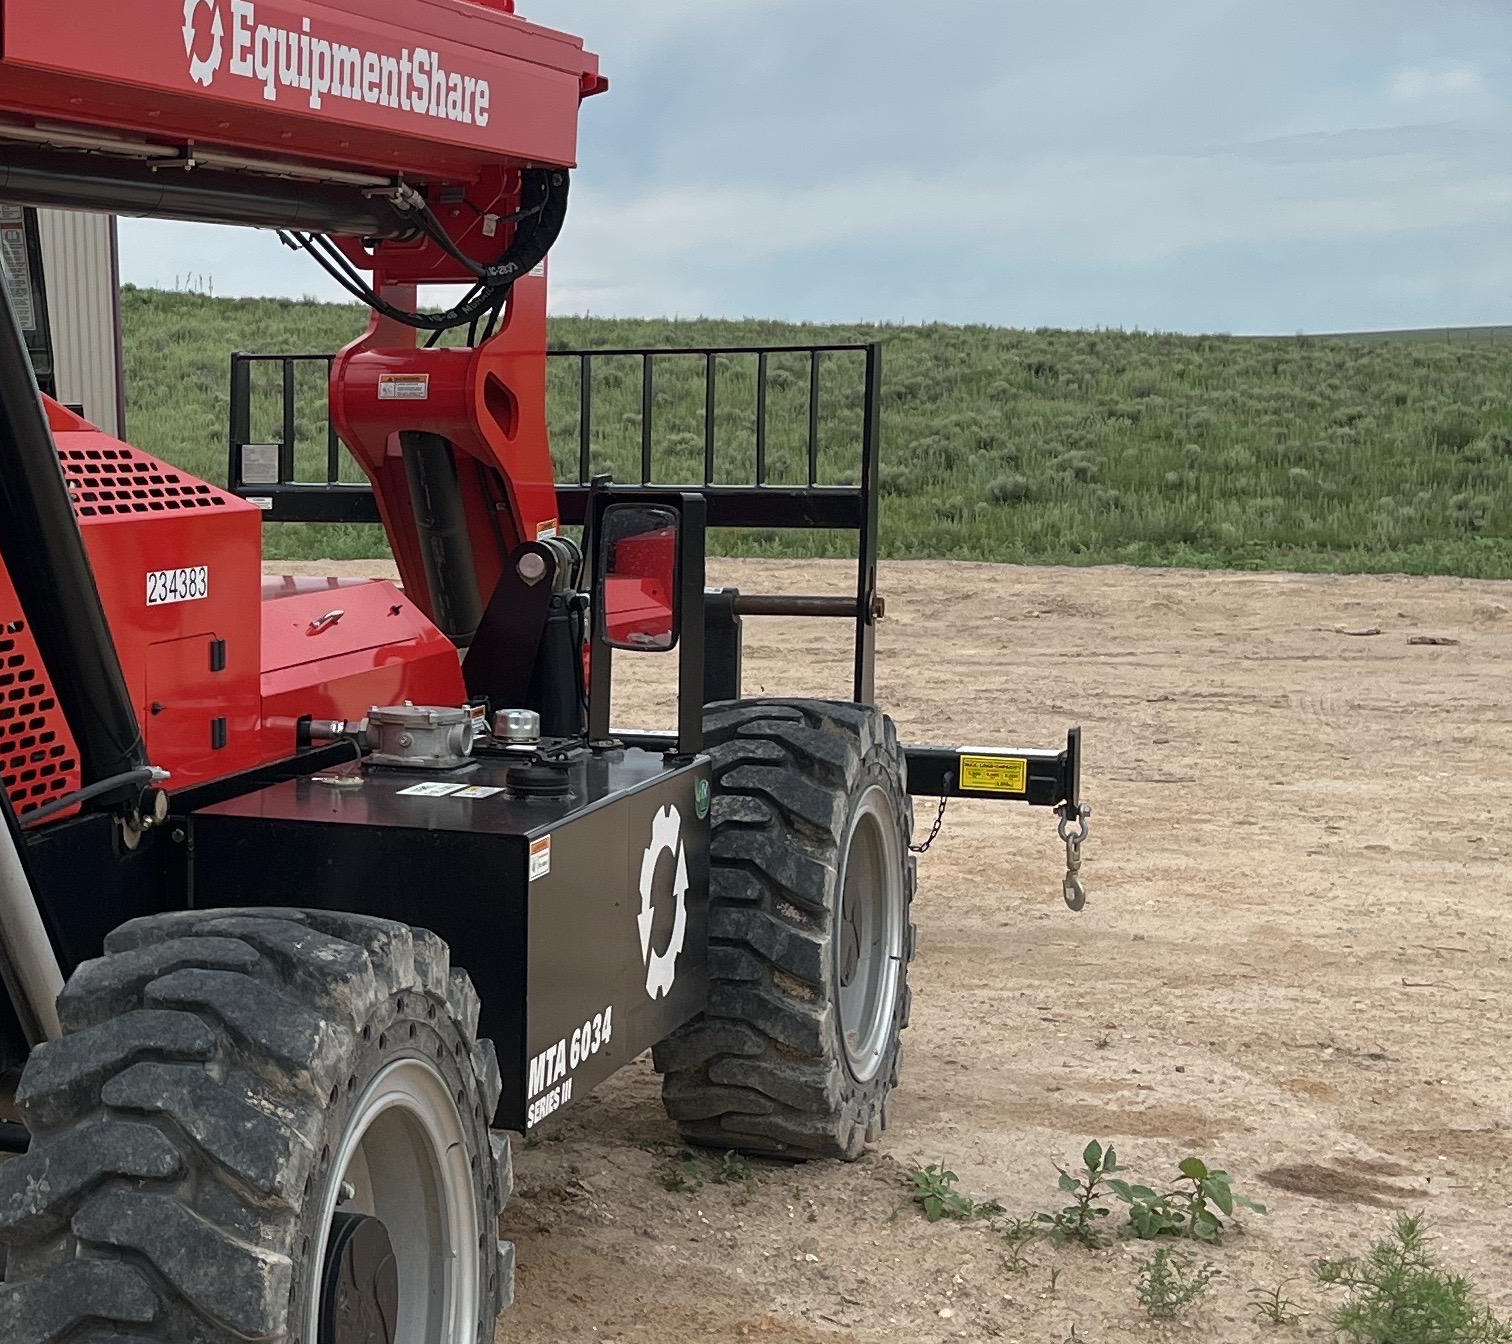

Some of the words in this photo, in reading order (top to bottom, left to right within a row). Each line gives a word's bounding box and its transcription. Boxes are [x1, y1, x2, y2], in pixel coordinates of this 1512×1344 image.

[148, 567, 207, 603] 234383
[528, 1038, 566, 1100] MTA
[570, 1005, 612, 1070] 6034
[527, 1086, 561, 1129] SERIES
[561, 1077, 573, 1105] III
